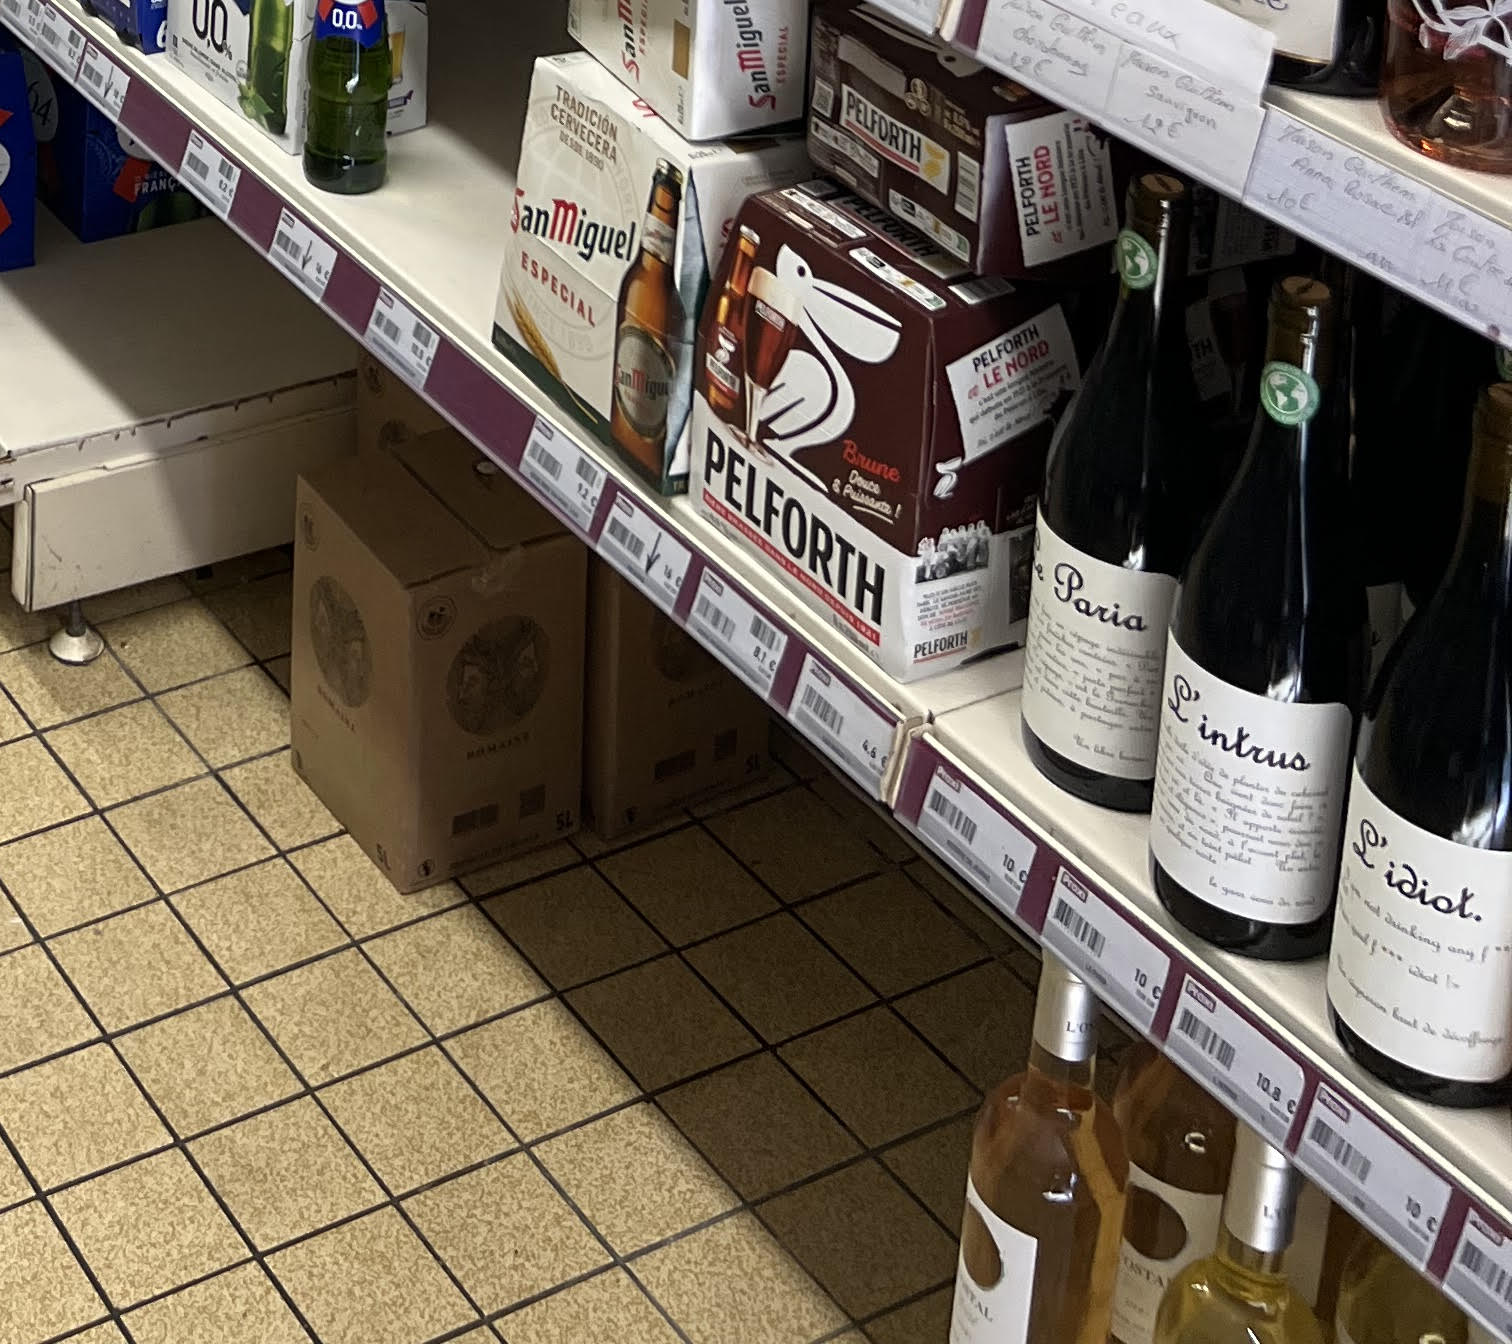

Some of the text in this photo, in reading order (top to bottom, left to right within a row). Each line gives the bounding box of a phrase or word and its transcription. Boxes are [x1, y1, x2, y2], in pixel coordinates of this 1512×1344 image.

[775, 25, 791, 85] ESPECIAL
[549, 103, 618, 163] CERVECERA
[554, 84, 618, 143] TRADICIÓN
[844, 90, 924, 166] PELFORTH
[1015, 156, 1040, 238] PELFORTH
[1034, 144, 1060, 226] LE NORD
[520, 252, 597, 329] ESPECIAL
[972, 324, 1040, 373] PELFORTH
[982, 339, 1050, 390] LE NORD
[831, 478, 842, 494] &
[842, 439, 901, 484] Brune
[848, 469, 882, 495] Douce
[703, 426, 886, 628] PELFORTH
[1054, 560, 1149, 633] Paria
[913, 630, 969, 659] PELFORTH
[1168, 674, 1311, 771] L'intrus
[1003, 851, 1016, 872] 10
[1134, 967, 1149, 991] 10
[1256, 1072, 1283, 1102] 10.8
[1406, 1194, 1423, 1219] 10
